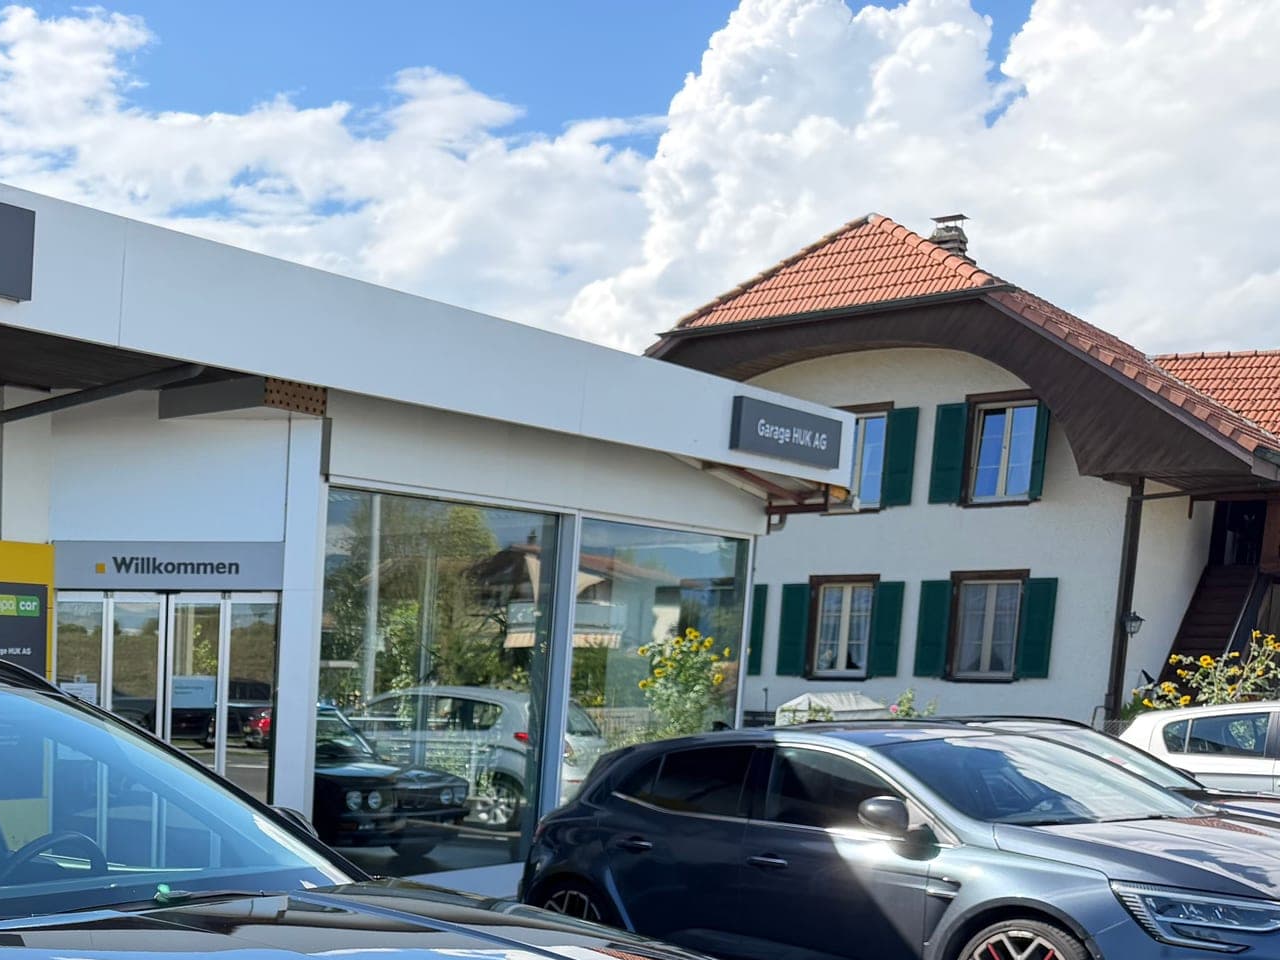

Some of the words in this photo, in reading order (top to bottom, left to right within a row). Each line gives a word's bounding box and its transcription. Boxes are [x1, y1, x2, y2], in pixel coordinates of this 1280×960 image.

[758, 419, 790, 444] Garage
[792, 427, 812, 447] HUK
[813, 431, 828, 450] AG
[112, 556, 240, 575] Willkommen
[19, 601, 37, 610] car
